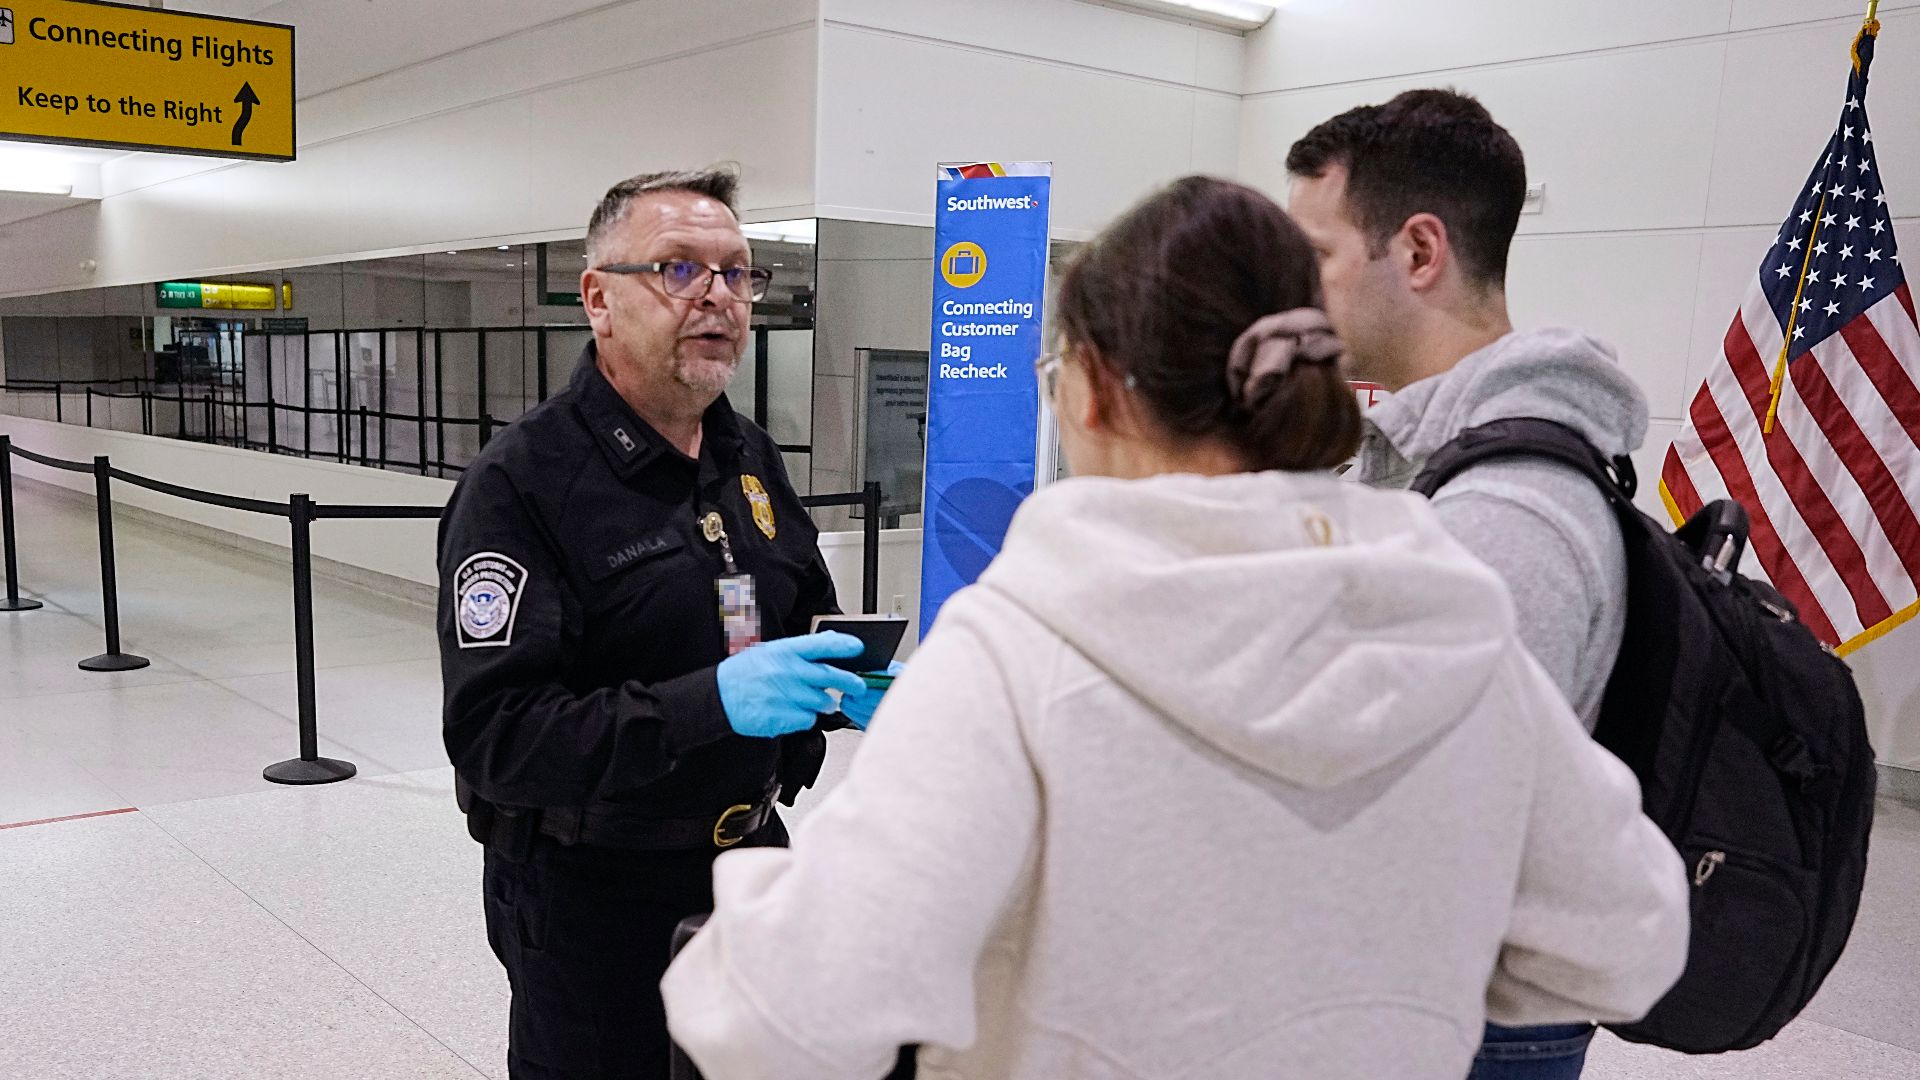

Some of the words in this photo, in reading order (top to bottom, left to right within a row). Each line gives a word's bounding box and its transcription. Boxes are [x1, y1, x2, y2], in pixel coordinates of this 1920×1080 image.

[29, 17, 181, 61] Connecting
[192, 36, 274, 67] Flights
[18, 86, 78, 115] Keep
[87, 94, 111, 113] to
[118, 96, 155, 117] the
[164, 100, 222, 126] Right
[947, 195, 1031, 211] Southwest
[942, 299, 1033, 319] Connecting
[941, 322, 1019, 336] Customer
[941, 343, 971, 361] Bag
[940, 363, 1008, 379] Recheck
